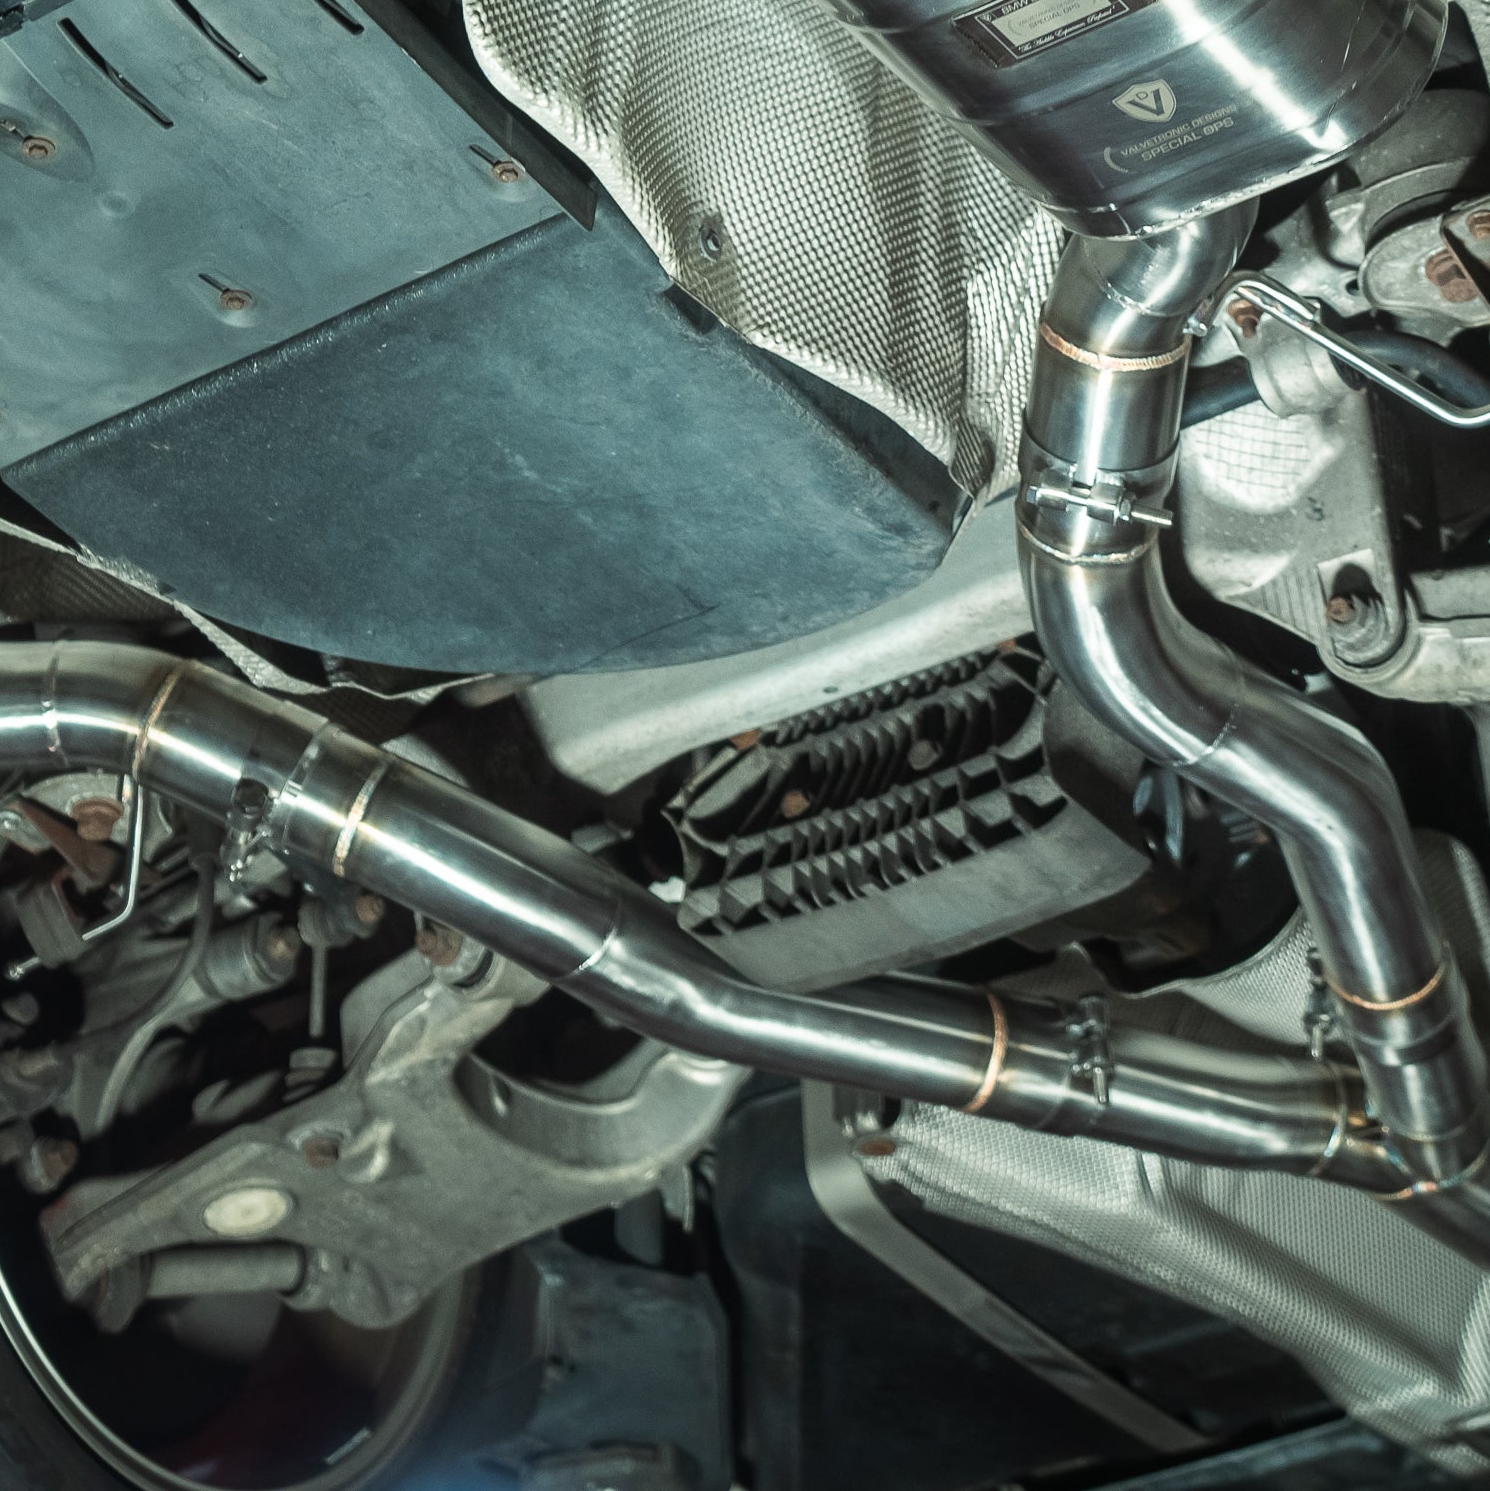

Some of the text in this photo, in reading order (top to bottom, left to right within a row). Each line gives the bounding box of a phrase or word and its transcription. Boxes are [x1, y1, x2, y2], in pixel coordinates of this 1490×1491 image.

[1120, 123, 1190, 156] VALVETRONIC
[1141, 116, 1234, 162] SPECIAL OPS
